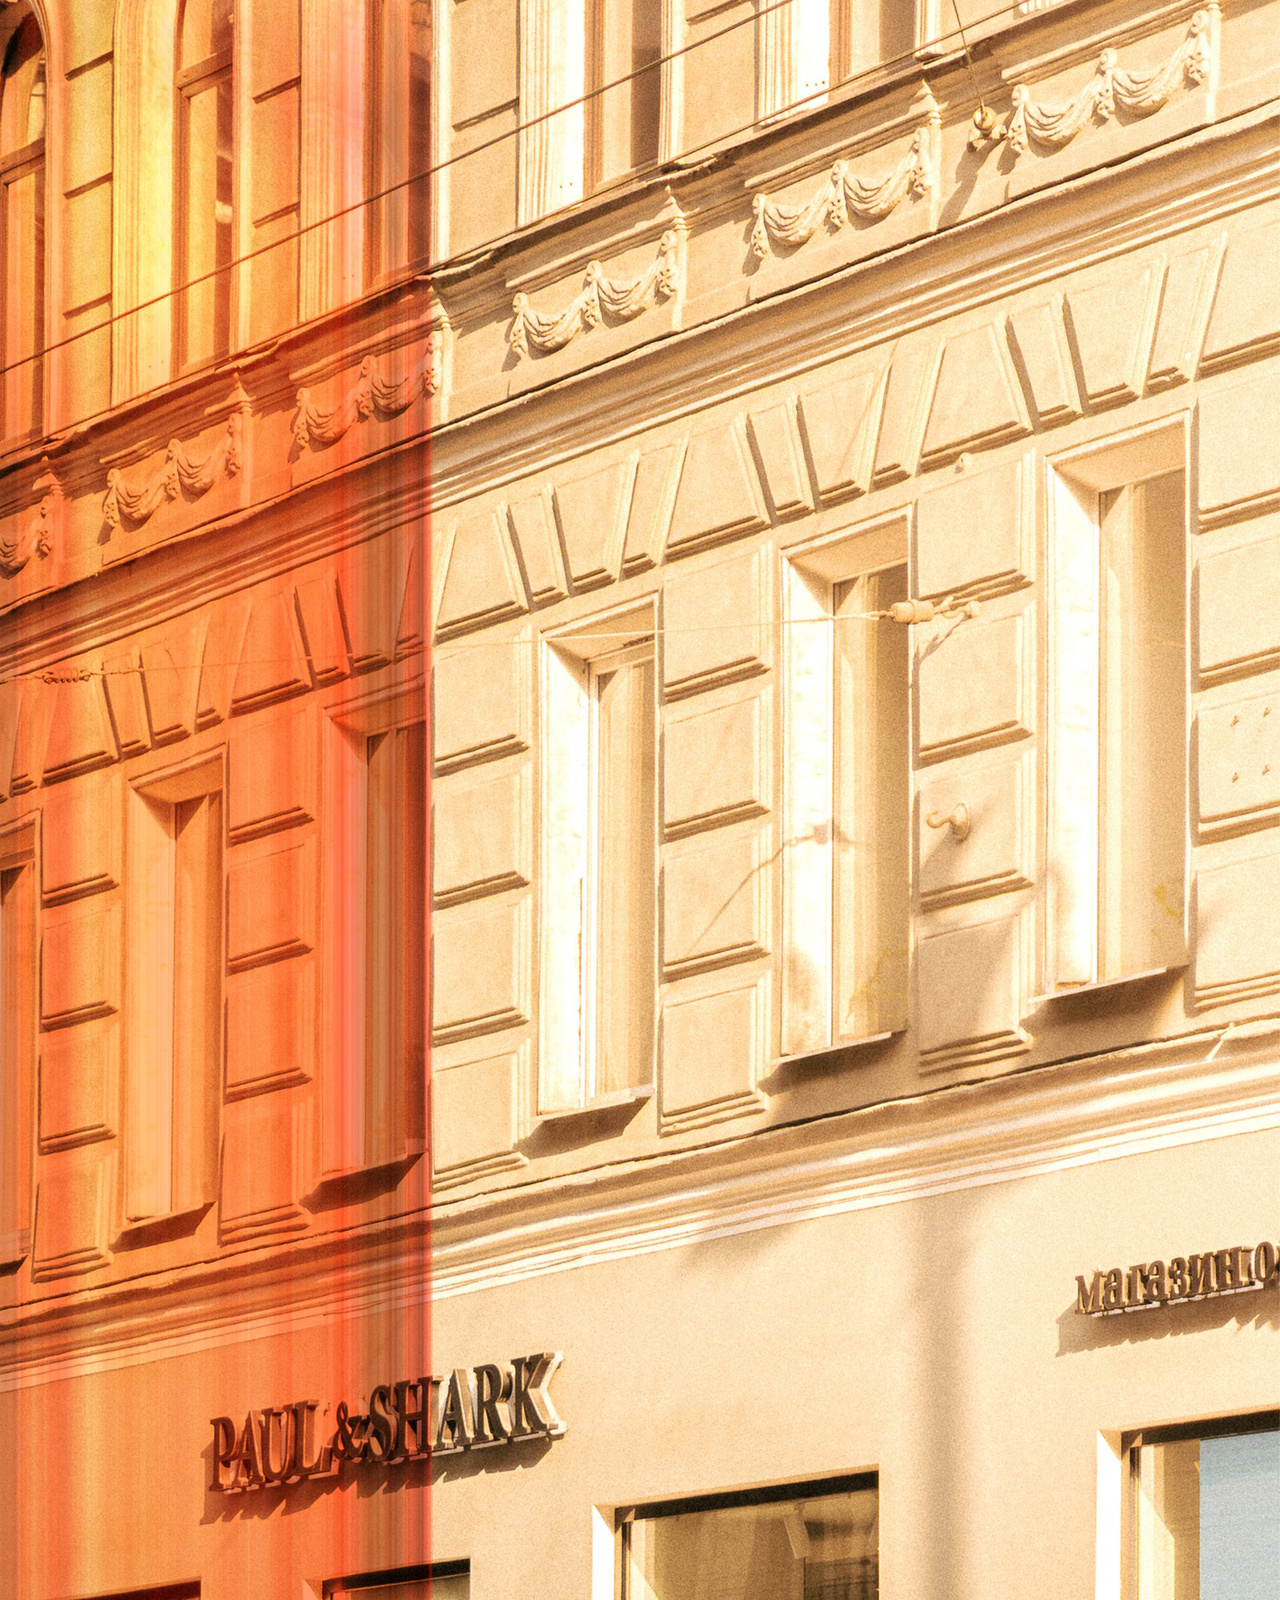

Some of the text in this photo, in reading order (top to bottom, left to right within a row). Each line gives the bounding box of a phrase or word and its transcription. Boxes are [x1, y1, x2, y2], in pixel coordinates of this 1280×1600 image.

[209, 1351, 565, 1492] PAUL & SHARK
